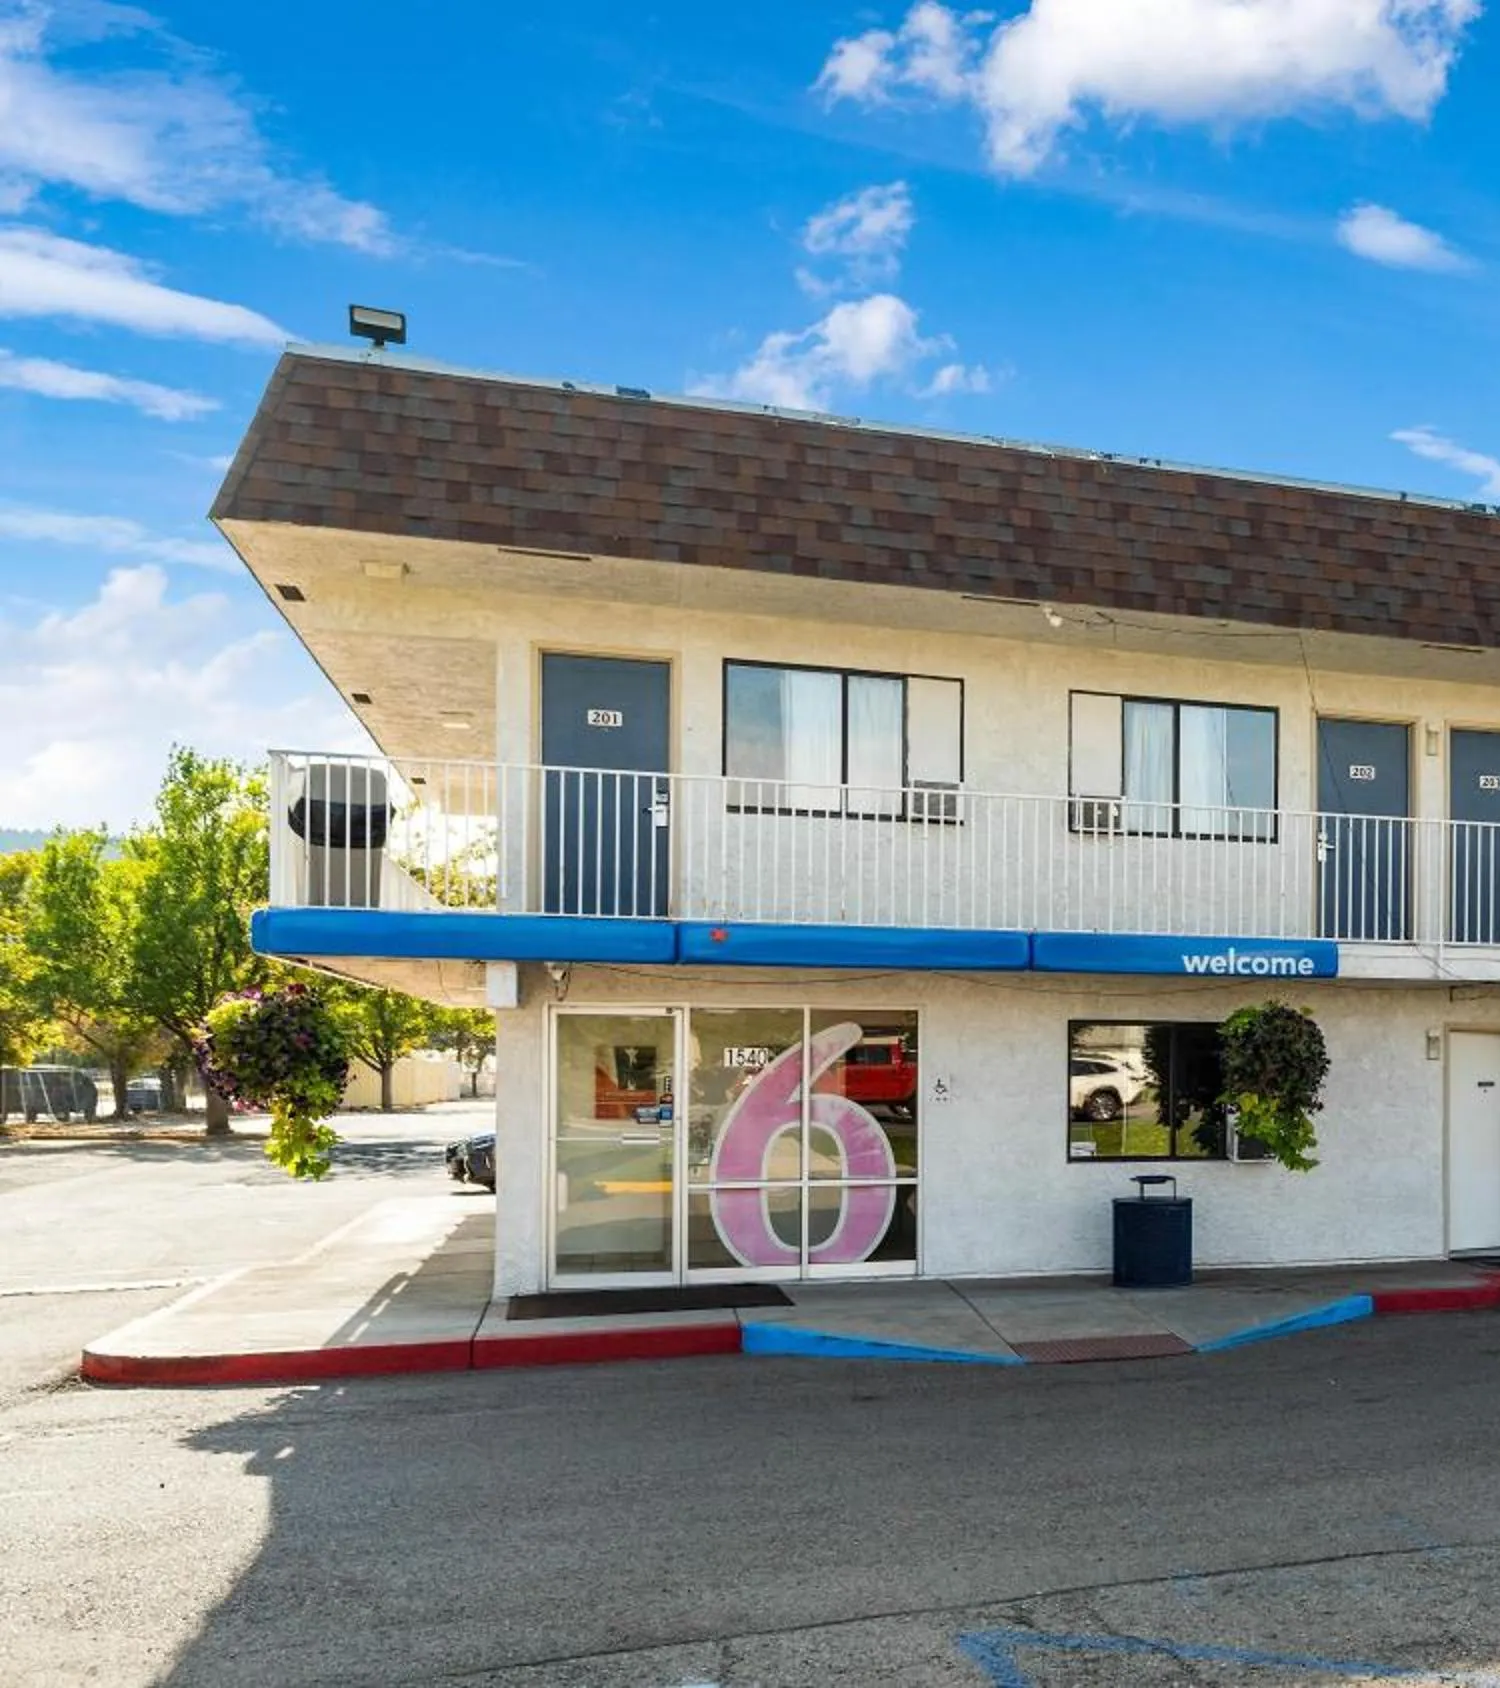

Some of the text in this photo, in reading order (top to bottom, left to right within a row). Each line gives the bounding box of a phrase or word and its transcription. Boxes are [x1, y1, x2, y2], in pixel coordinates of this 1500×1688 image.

[591, 711, 617, 725] 201
[1182, 947, 1315, 975] welcome
[726, 1049, 767, 1067] 1540
[709, 1022, 896, 1268] 6
